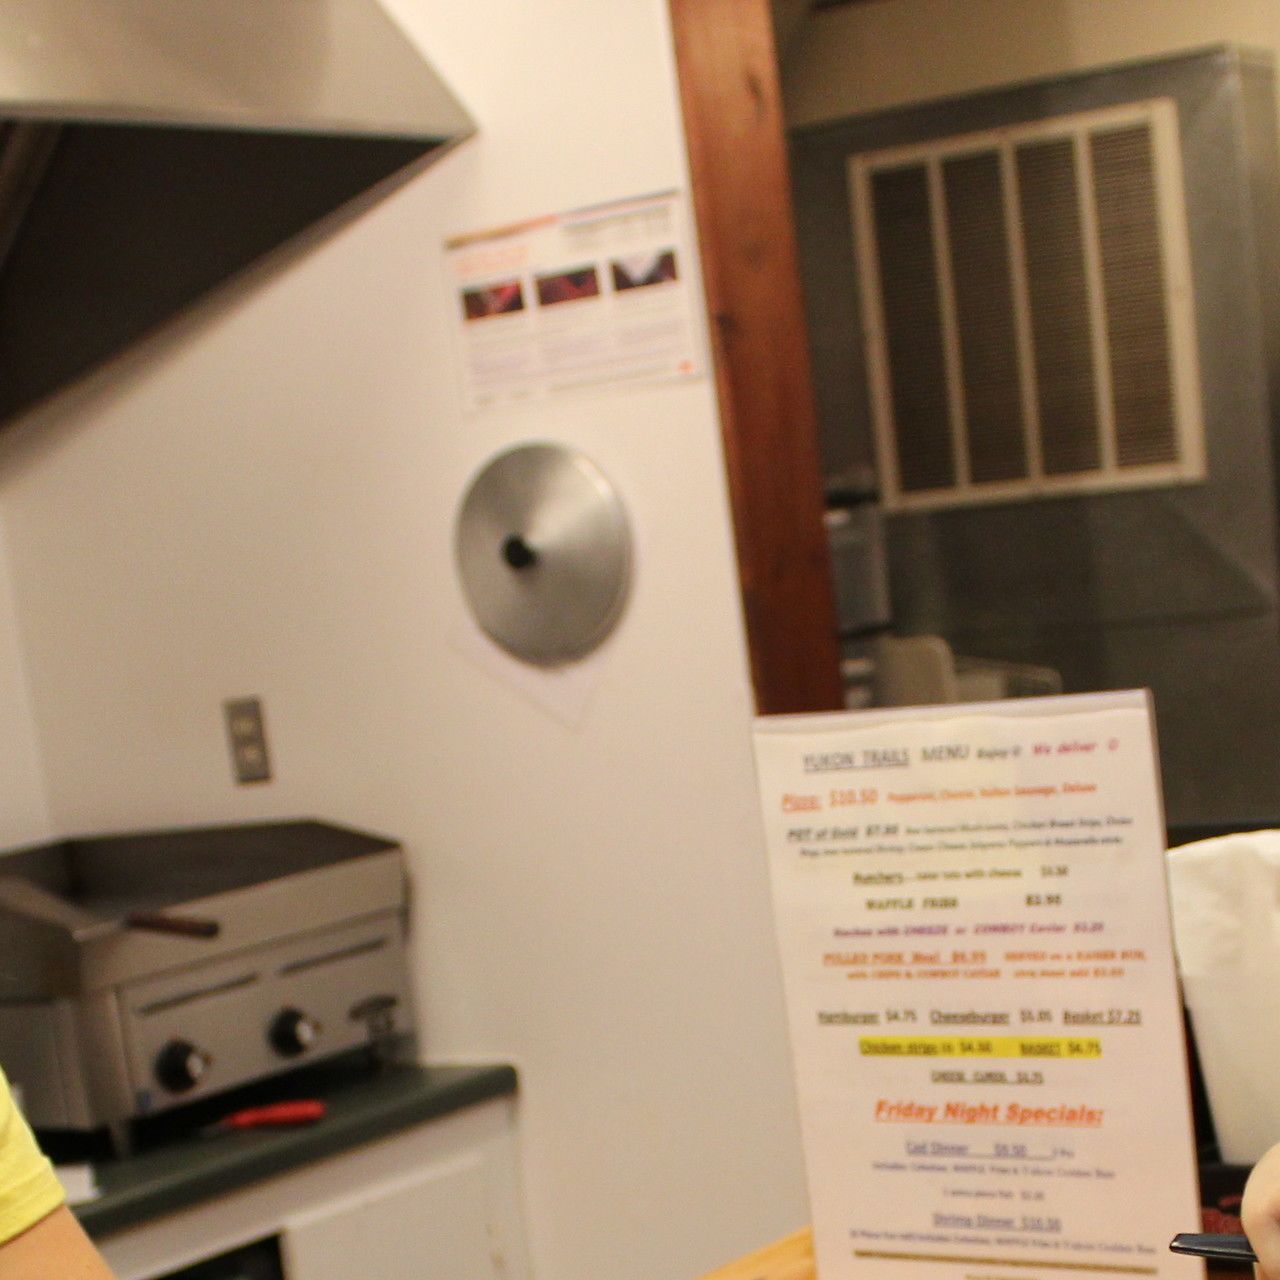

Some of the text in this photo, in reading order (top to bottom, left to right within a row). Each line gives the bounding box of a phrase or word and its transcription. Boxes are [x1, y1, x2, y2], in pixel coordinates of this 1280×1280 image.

[921, 743, 971, 762] MENU
[874, 1099, 1105, 1127] Friday Night Specials:
